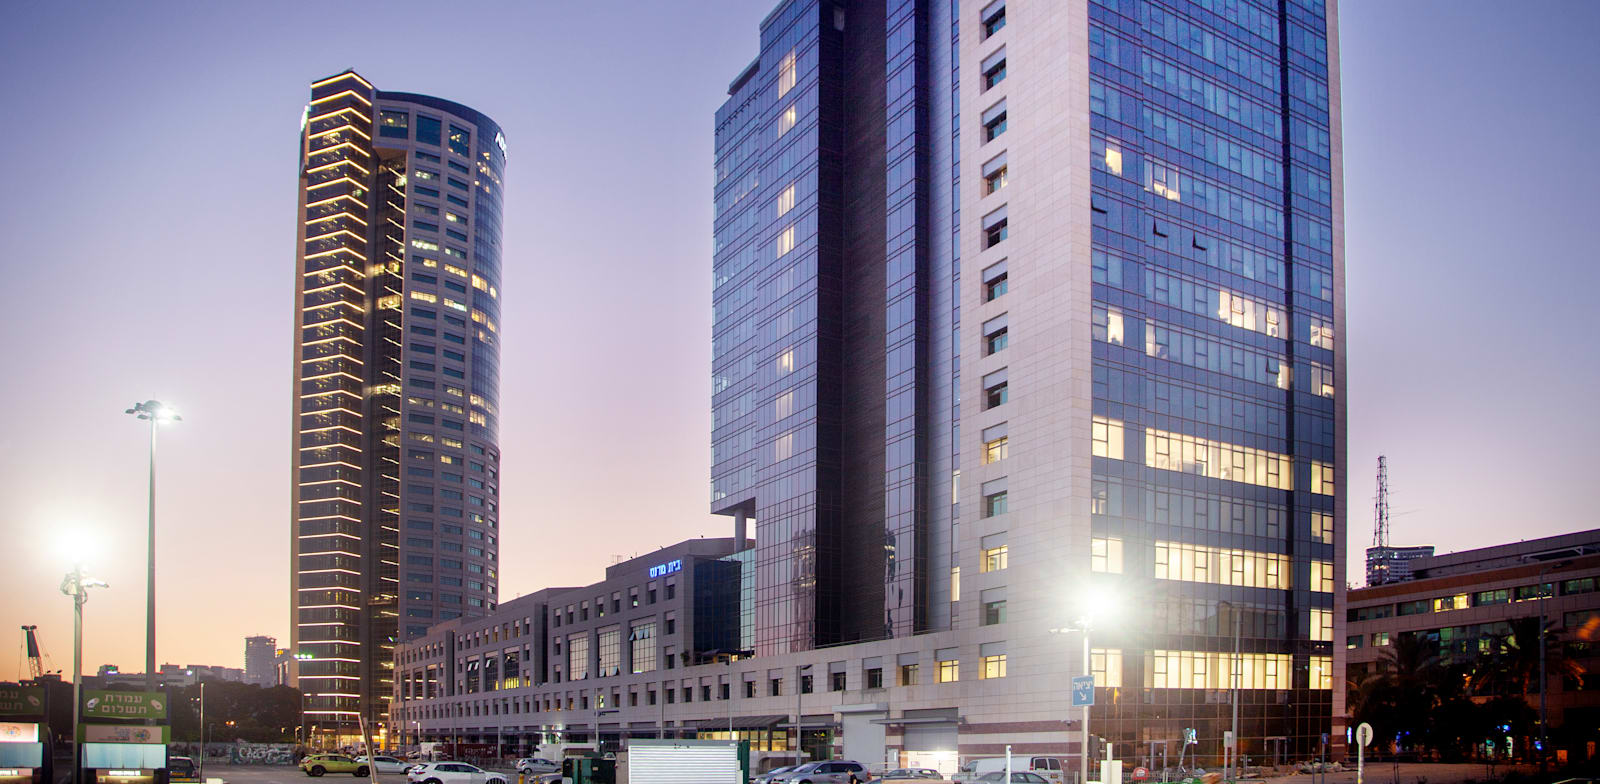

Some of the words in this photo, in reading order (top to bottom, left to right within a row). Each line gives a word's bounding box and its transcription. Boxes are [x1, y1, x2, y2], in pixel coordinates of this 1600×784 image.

[667, 559, 681, 573] בית
[1073, 680, 1093, 691] יציאה
[104, 694, 143, 703] עמדת
[101, 704, 147, 714] תשלום
